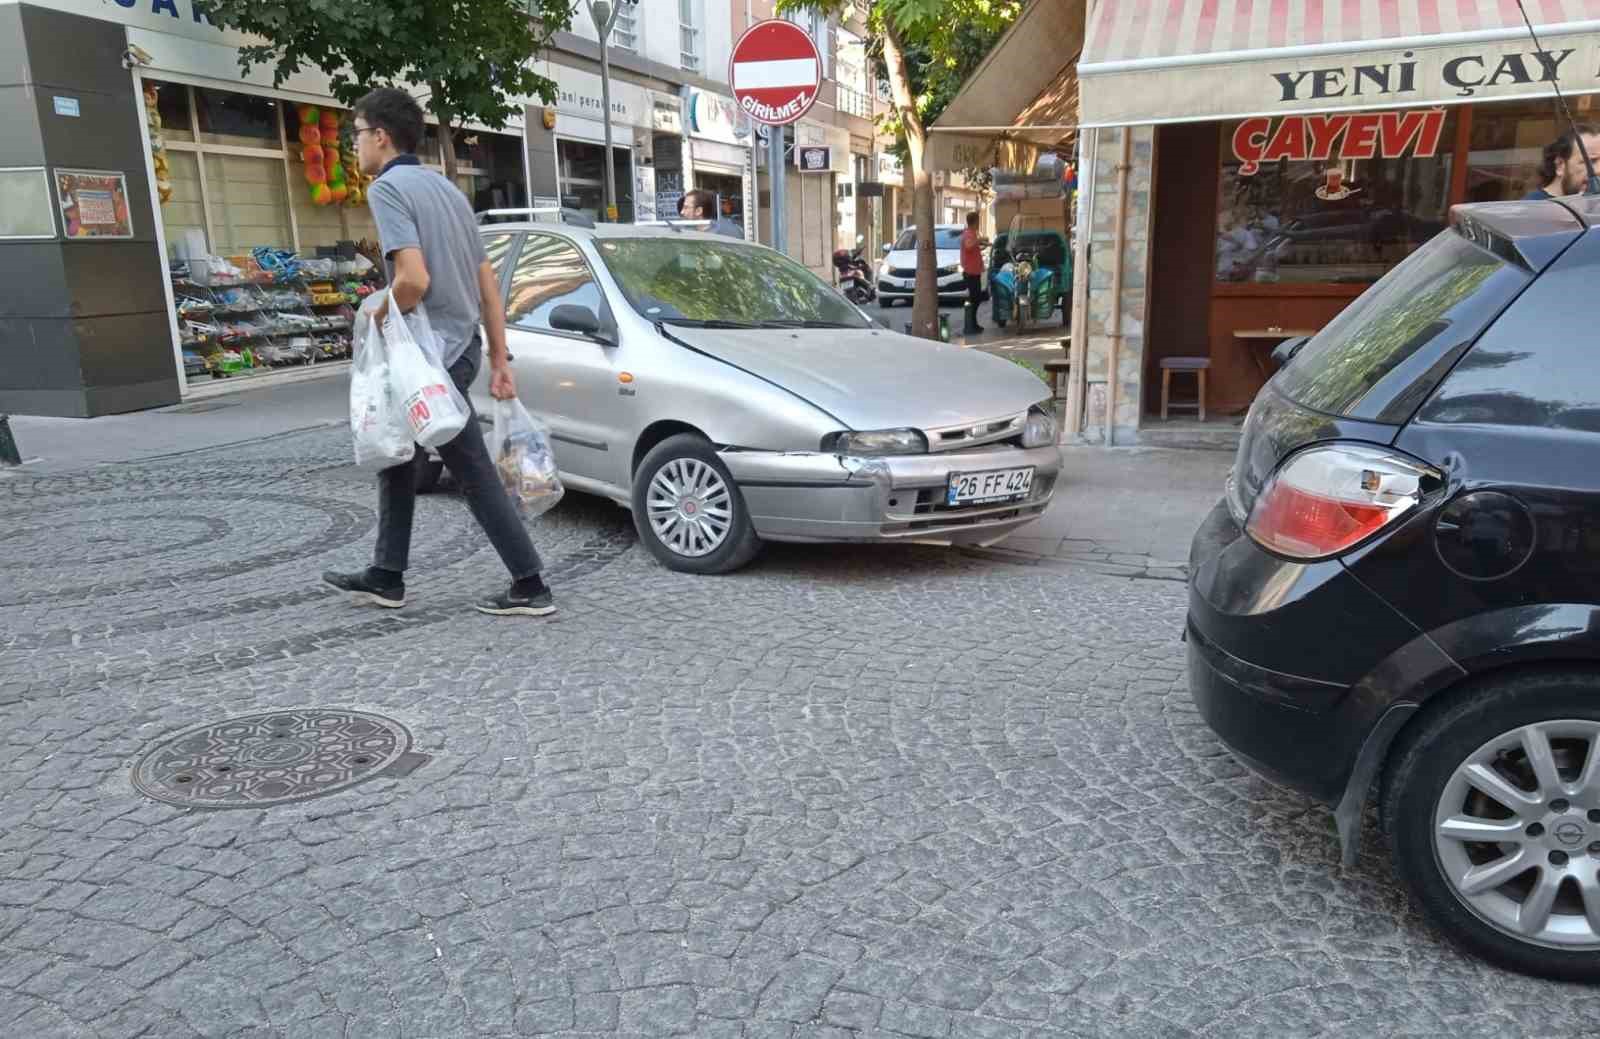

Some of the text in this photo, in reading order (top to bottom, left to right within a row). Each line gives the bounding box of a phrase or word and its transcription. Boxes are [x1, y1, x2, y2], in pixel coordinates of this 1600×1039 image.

[1271, 51, 1418, 101] YENİ
[1442, 48, 1577, 97] ÇAY
[742, 91, 810, 120] GİRİLMEZ
[1231, 105, 1448, 176] ÇAYEVİ
[957, 477, 978, 497] 26
[983, 474, 1005, 494] FF
[1007, 471, 1033, 492] 424
